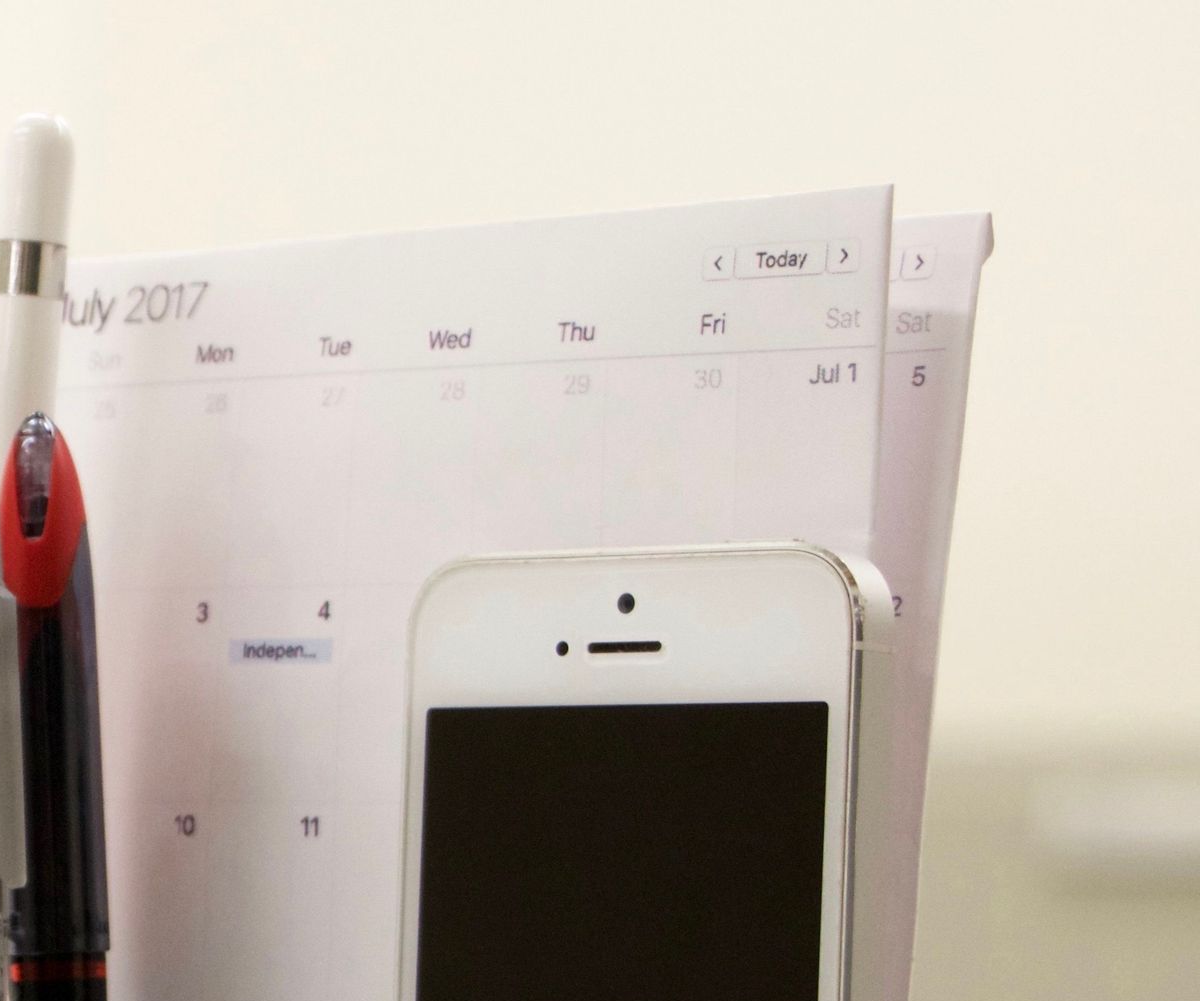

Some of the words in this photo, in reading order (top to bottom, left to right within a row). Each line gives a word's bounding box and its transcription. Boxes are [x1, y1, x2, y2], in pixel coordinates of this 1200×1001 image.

[755, 250, 808, 272] Today
[124, 280, 209, 324] 2017
[895, 311, 932, 335] Sat
[195, 344, 234, 365] Mon
[319, 336, 353, 357] Tue
[428, 328, 472, 351] Wed
[558, 321, 596, 343] Thu
[700, 313, 727, 336] Fri
[825, 308, 861, 330] Sat
[203, 393, 228, 415] 26
[321, 387, 347, 408] 27
[439, 379, 466, 402] 28
[563, 374, 592, 396] 29
[693, 368, 723, 390] 30
[809, 362, 840, 386] Jul
[846, 362, 859, 384] 1
[911, 365, 927, 388] 5
[196, 602, 209, 624] 3
[317, 600, 332, 621] 4
[242, 642, 317, 662] Indepen...
[174, 813, 196, 837] 10
[300, 815, 321, 837] 11
